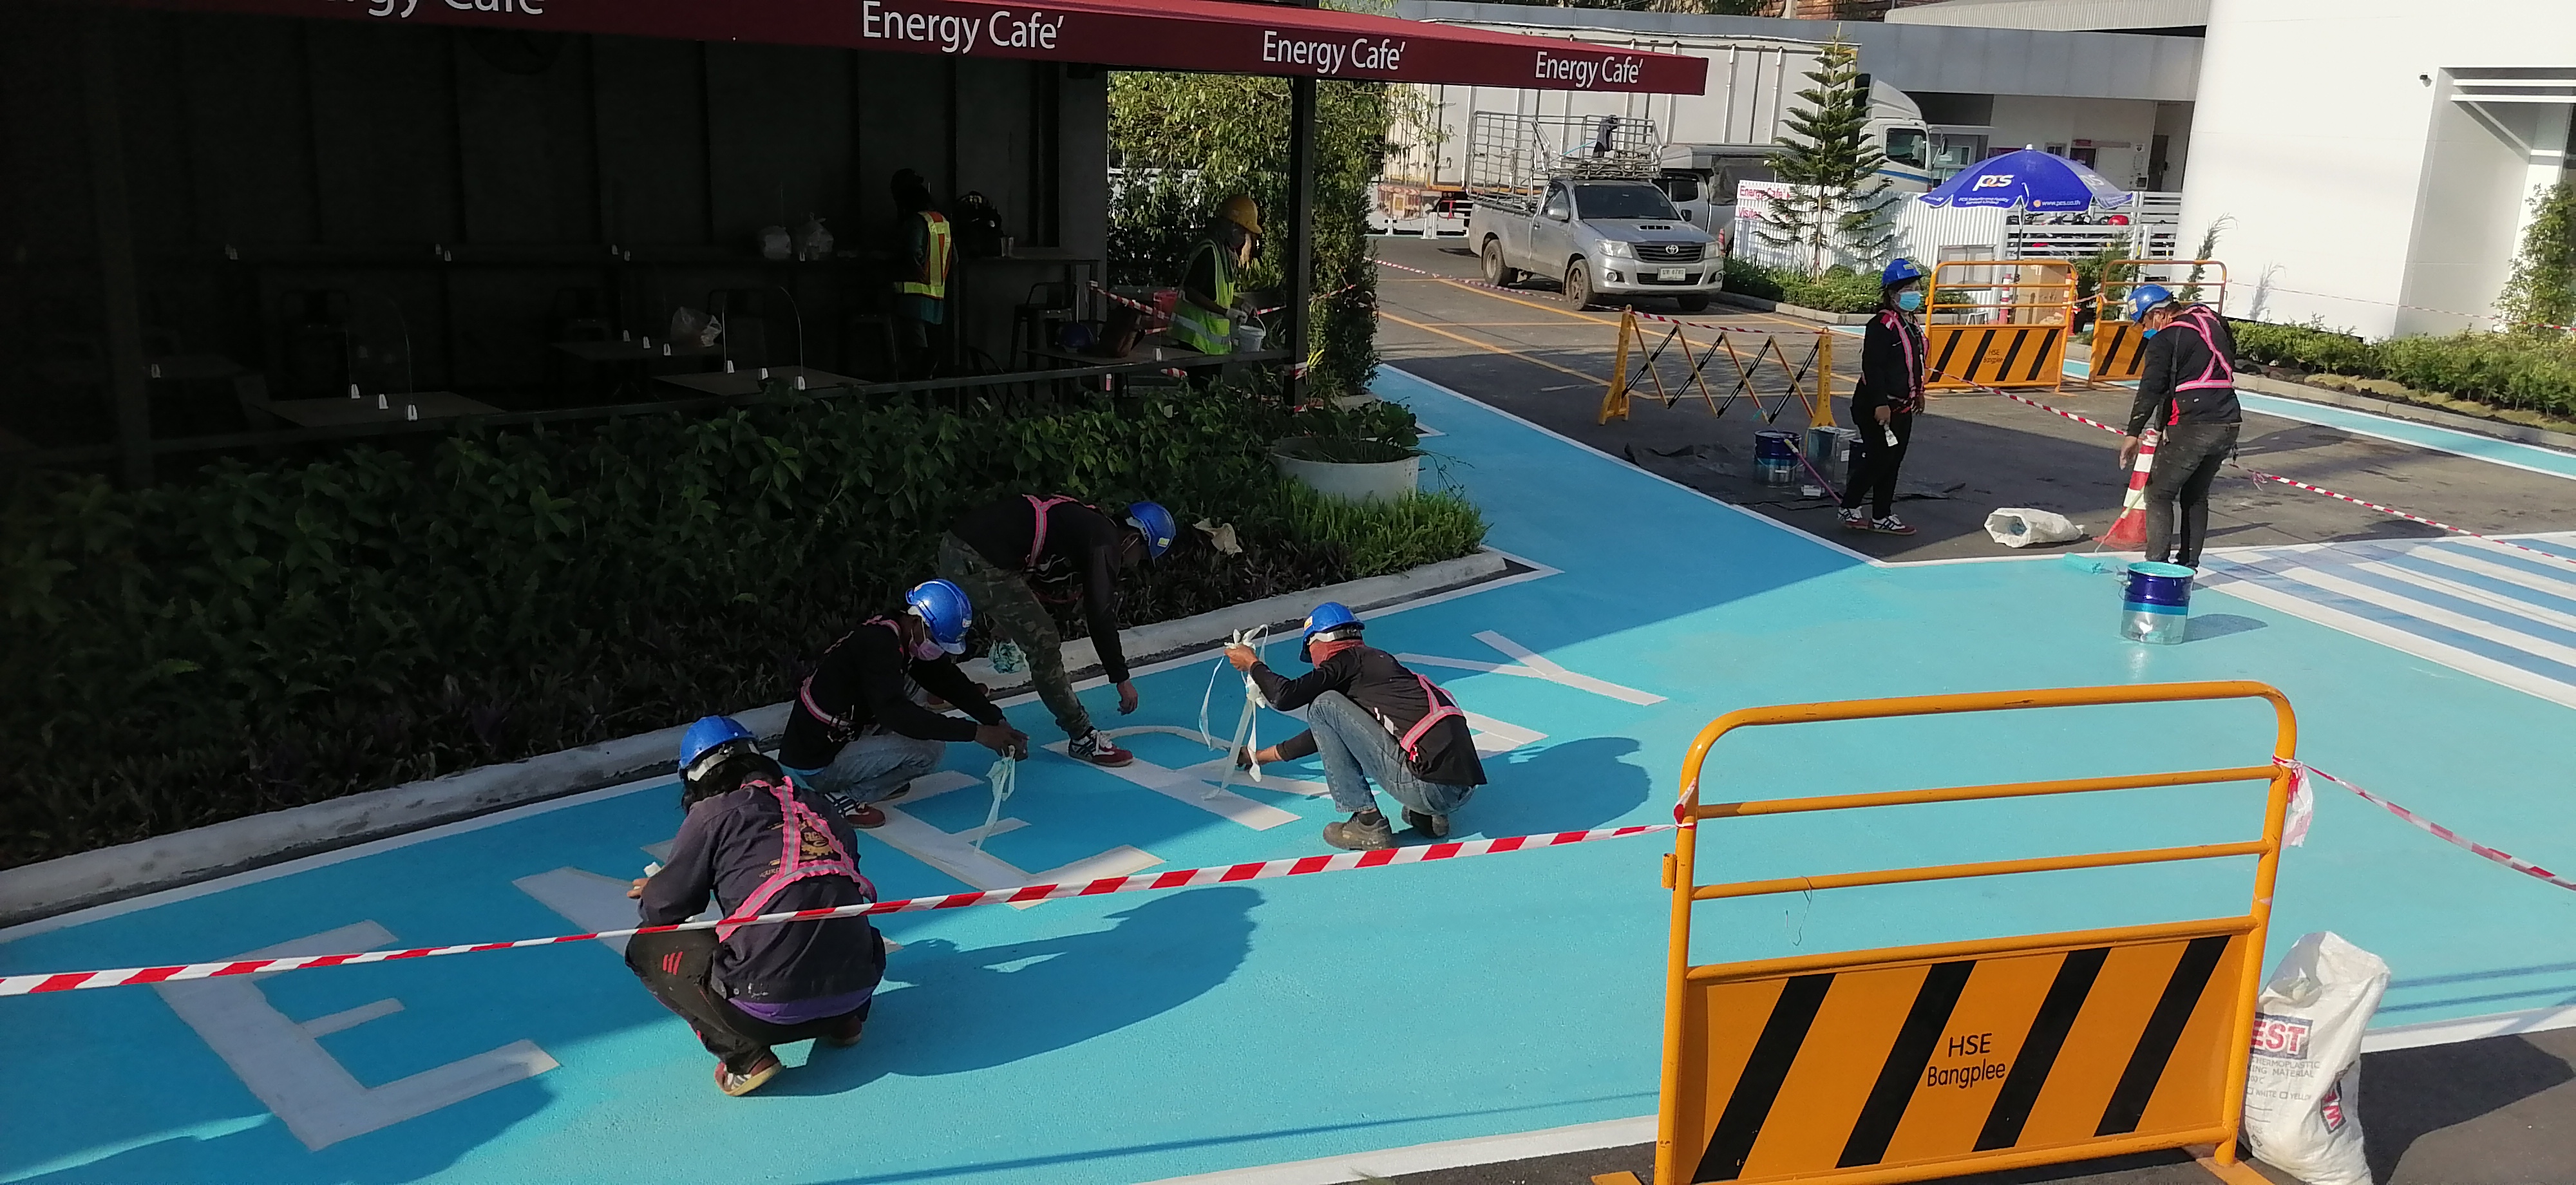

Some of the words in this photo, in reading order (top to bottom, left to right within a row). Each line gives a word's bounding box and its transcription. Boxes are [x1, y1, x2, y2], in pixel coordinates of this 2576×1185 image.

[863, 0, 981, 54] Energy
[989, 10, 1064, 50] Cafe'
[1263, 30, 1347, 75] Energy
[1351, 38, 1406, 70] Cafe'
[1535, 51, 1598, 88] Energy
[1602, 56, 1643, 84] Cafe'
[1948, 1032, 1993, 1057] HSE
[2250, 1019, 2306, 1052] EST
[1927, 1057, 2006, 1089] Bangplee
[2272, 1067, 2315, 1078] MATERIAL
[2256, 1089, 2277, 1099] WHITE
